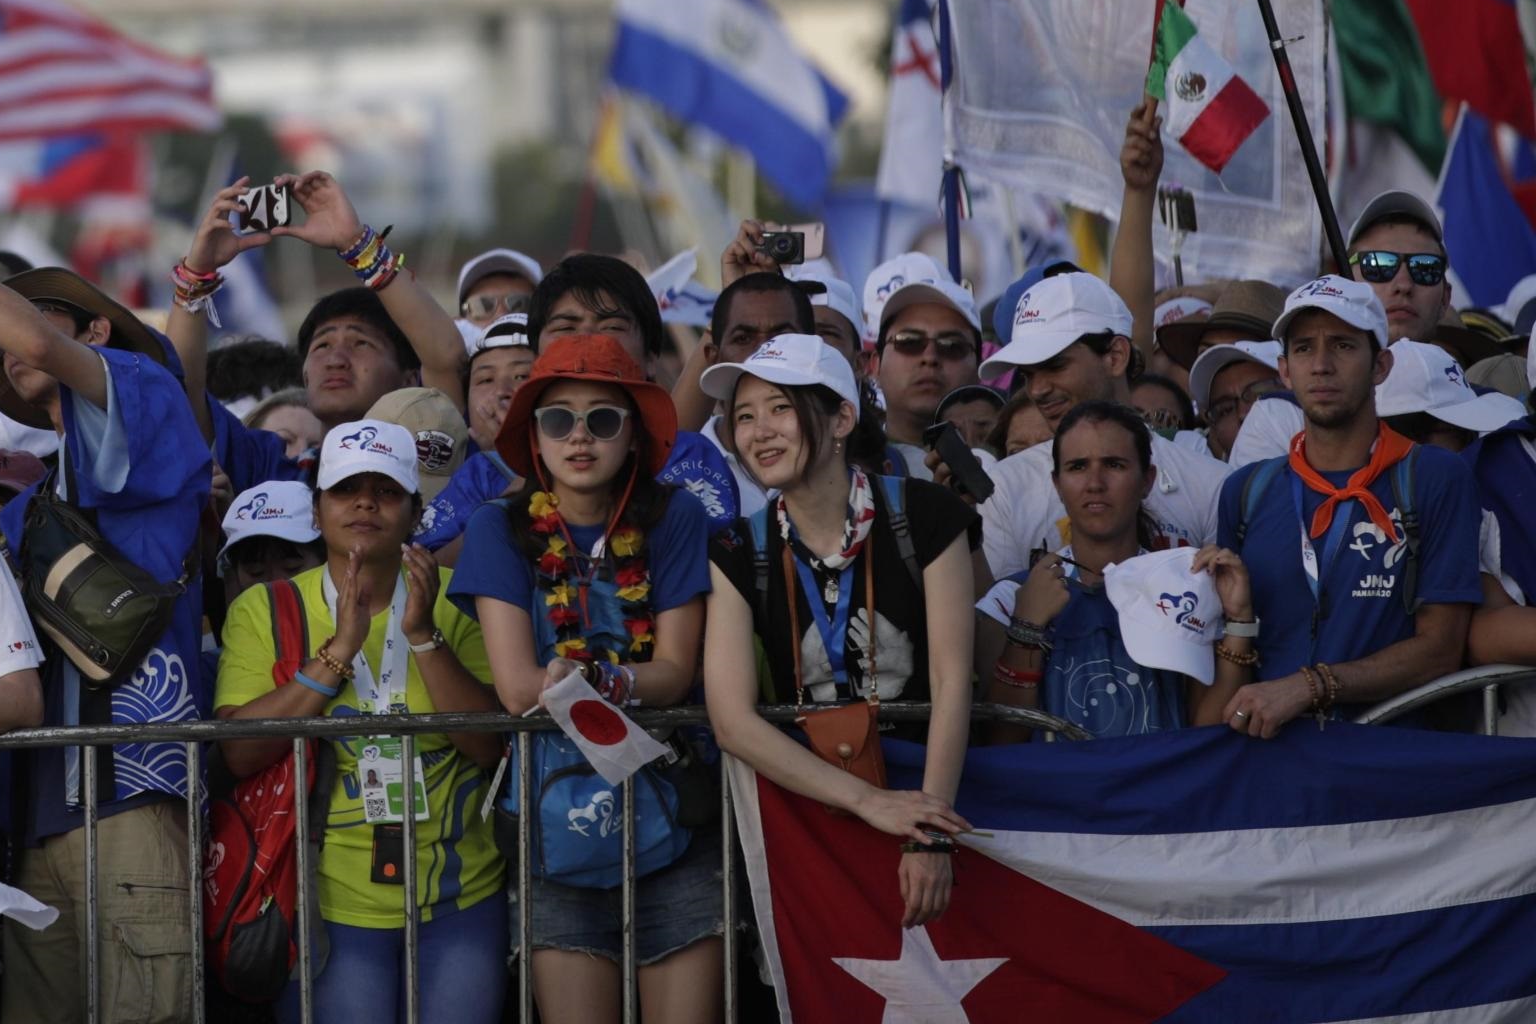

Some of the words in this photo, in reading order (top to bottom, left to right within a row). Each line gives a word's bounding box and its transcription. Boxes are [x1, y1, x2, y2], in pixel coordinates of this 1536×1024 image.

[371, 441, 393, 453] JMJ
[262, 507, 284, 516] JMJ
[1359, 574, 1395, 589] JMJ
[1187, 616, 1206, 629] JMJ
